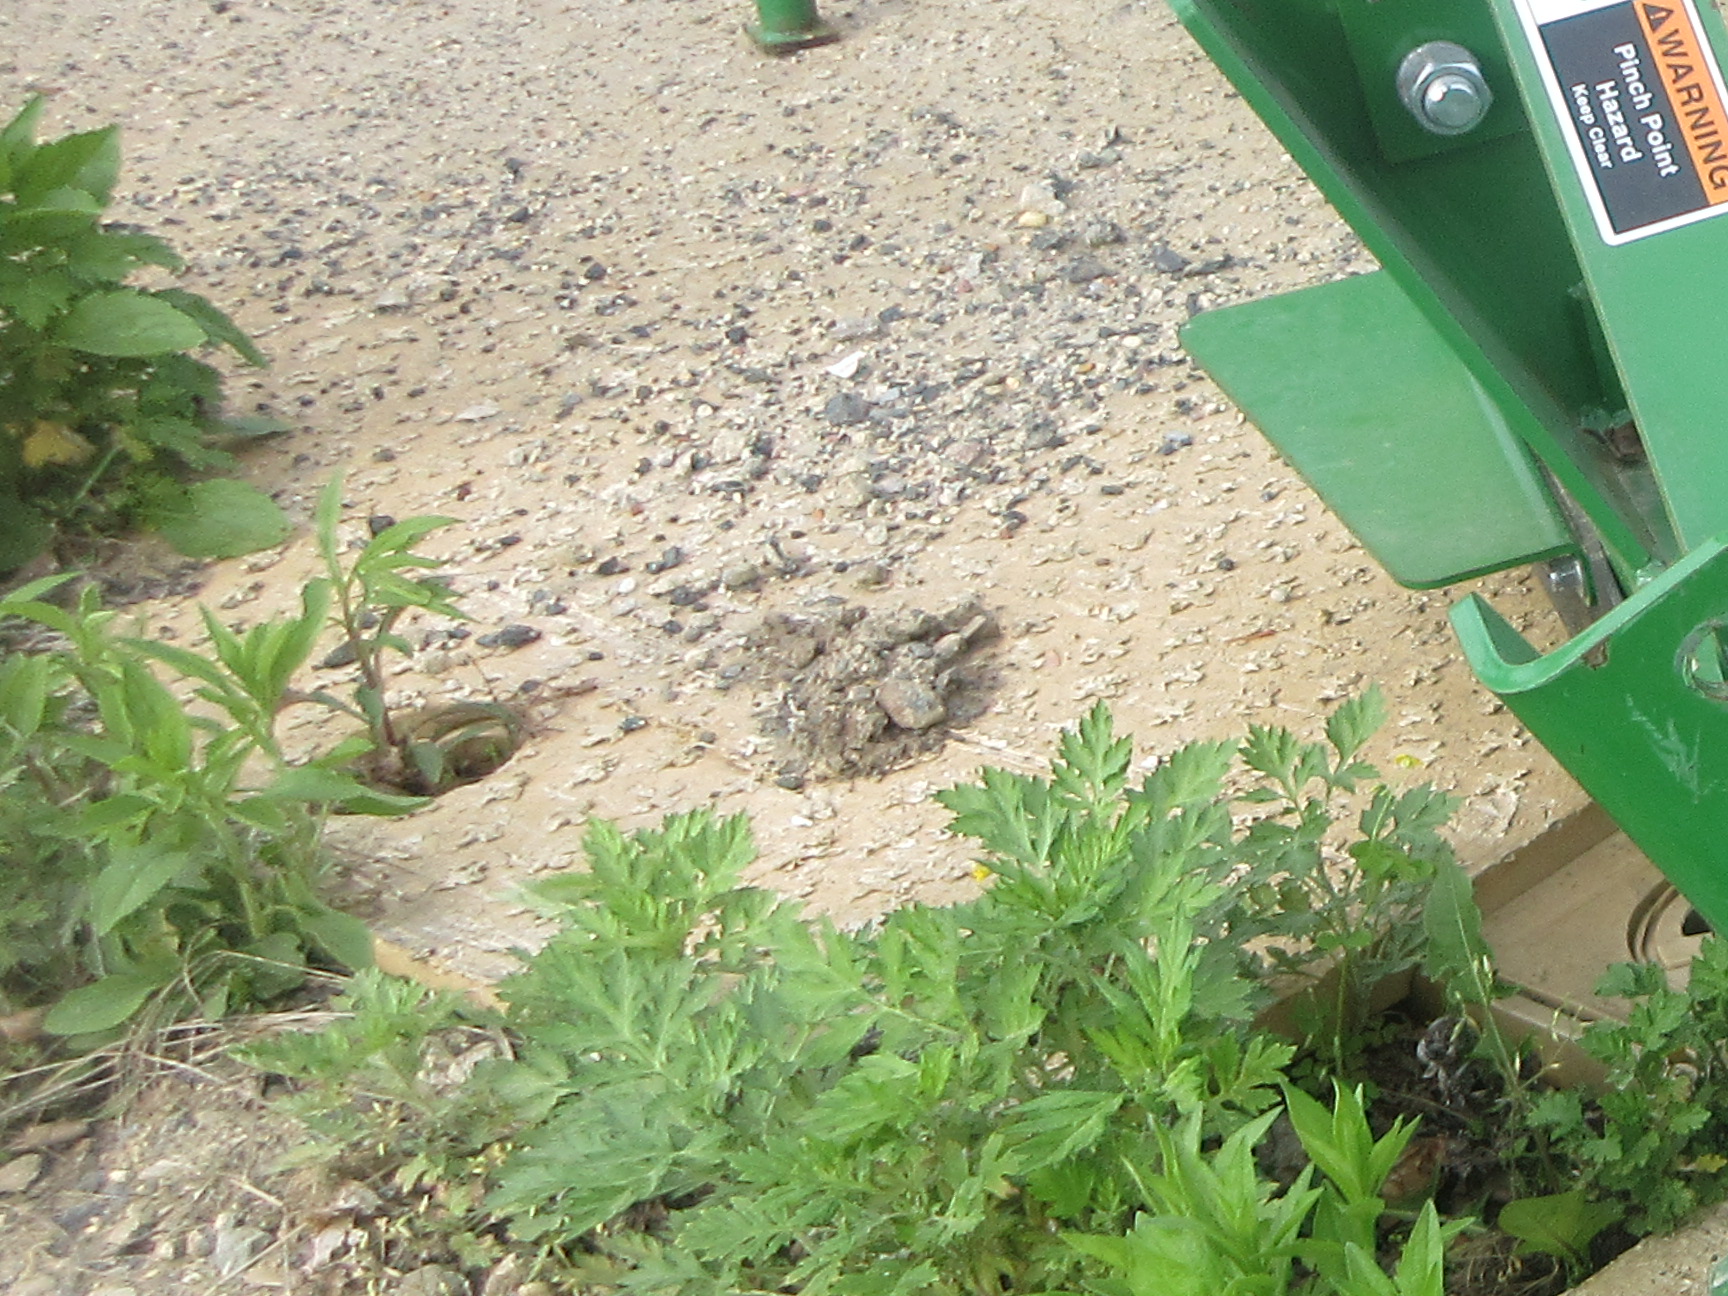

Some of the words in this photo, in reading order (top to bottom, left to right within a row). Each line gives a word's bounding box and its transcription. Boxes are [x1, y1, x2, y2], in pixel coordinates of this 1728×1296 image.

[1570, 82, 1596, 125] Keep
[1588, 126, 1615, 169] Clear
[1595, 80, 1643, 163] Hazard
[1614, 41, 1652, 111] Pinch
[1641, 113, 1680, 177] Point
